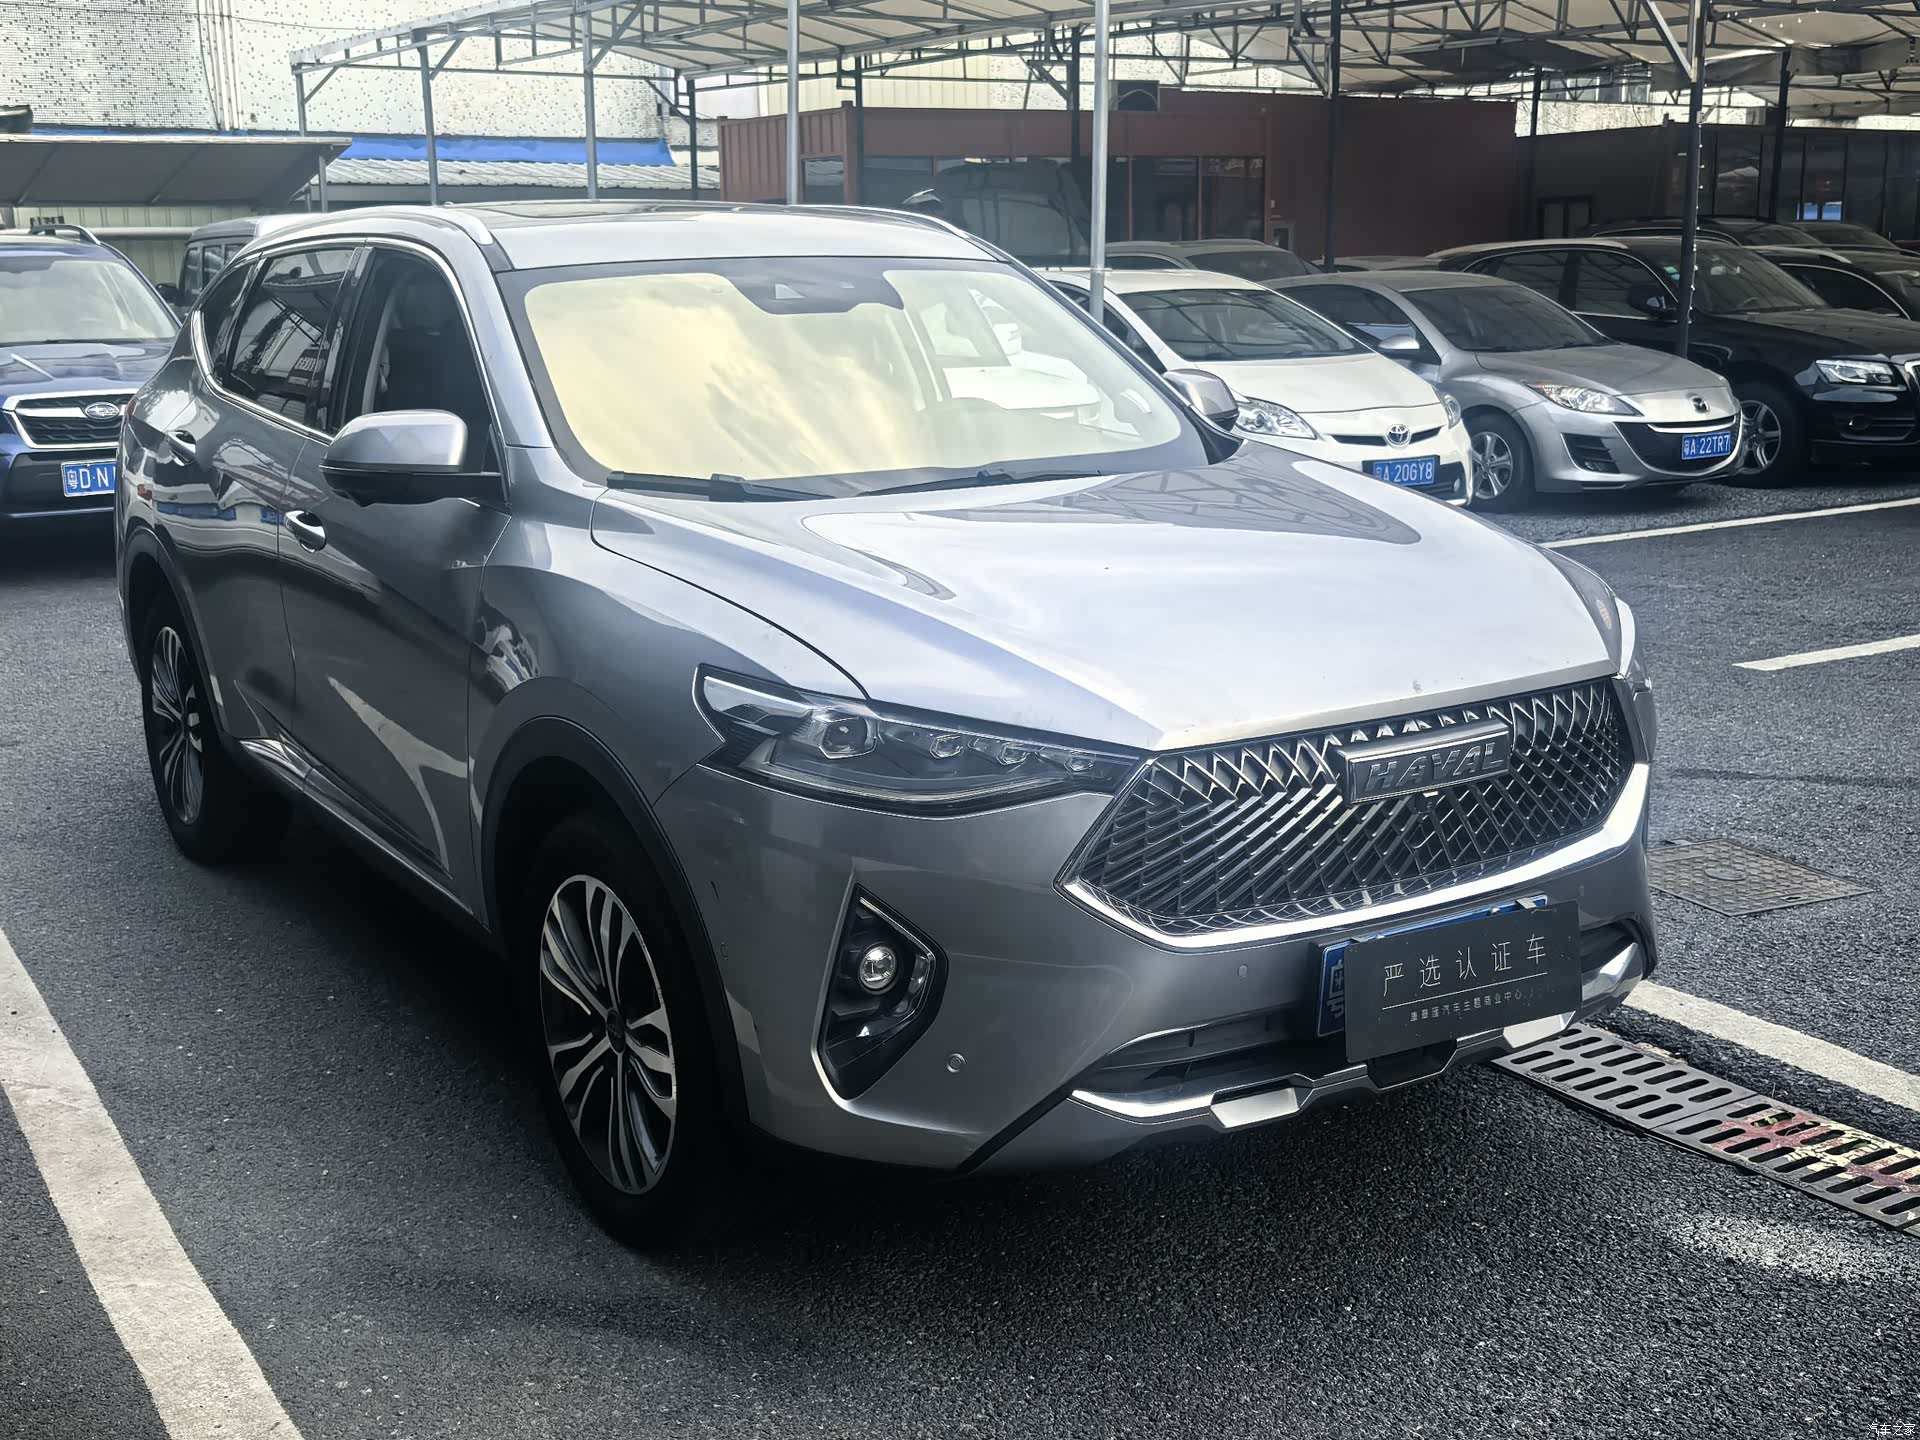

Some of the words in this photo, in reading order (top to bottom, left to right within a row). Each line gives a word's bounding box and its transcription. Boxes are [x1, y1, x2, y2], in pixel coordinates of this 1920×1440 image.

[1364, 742, 1504, 792] HAVAL
[1383, 933, 1547, 997] 严选认证车
